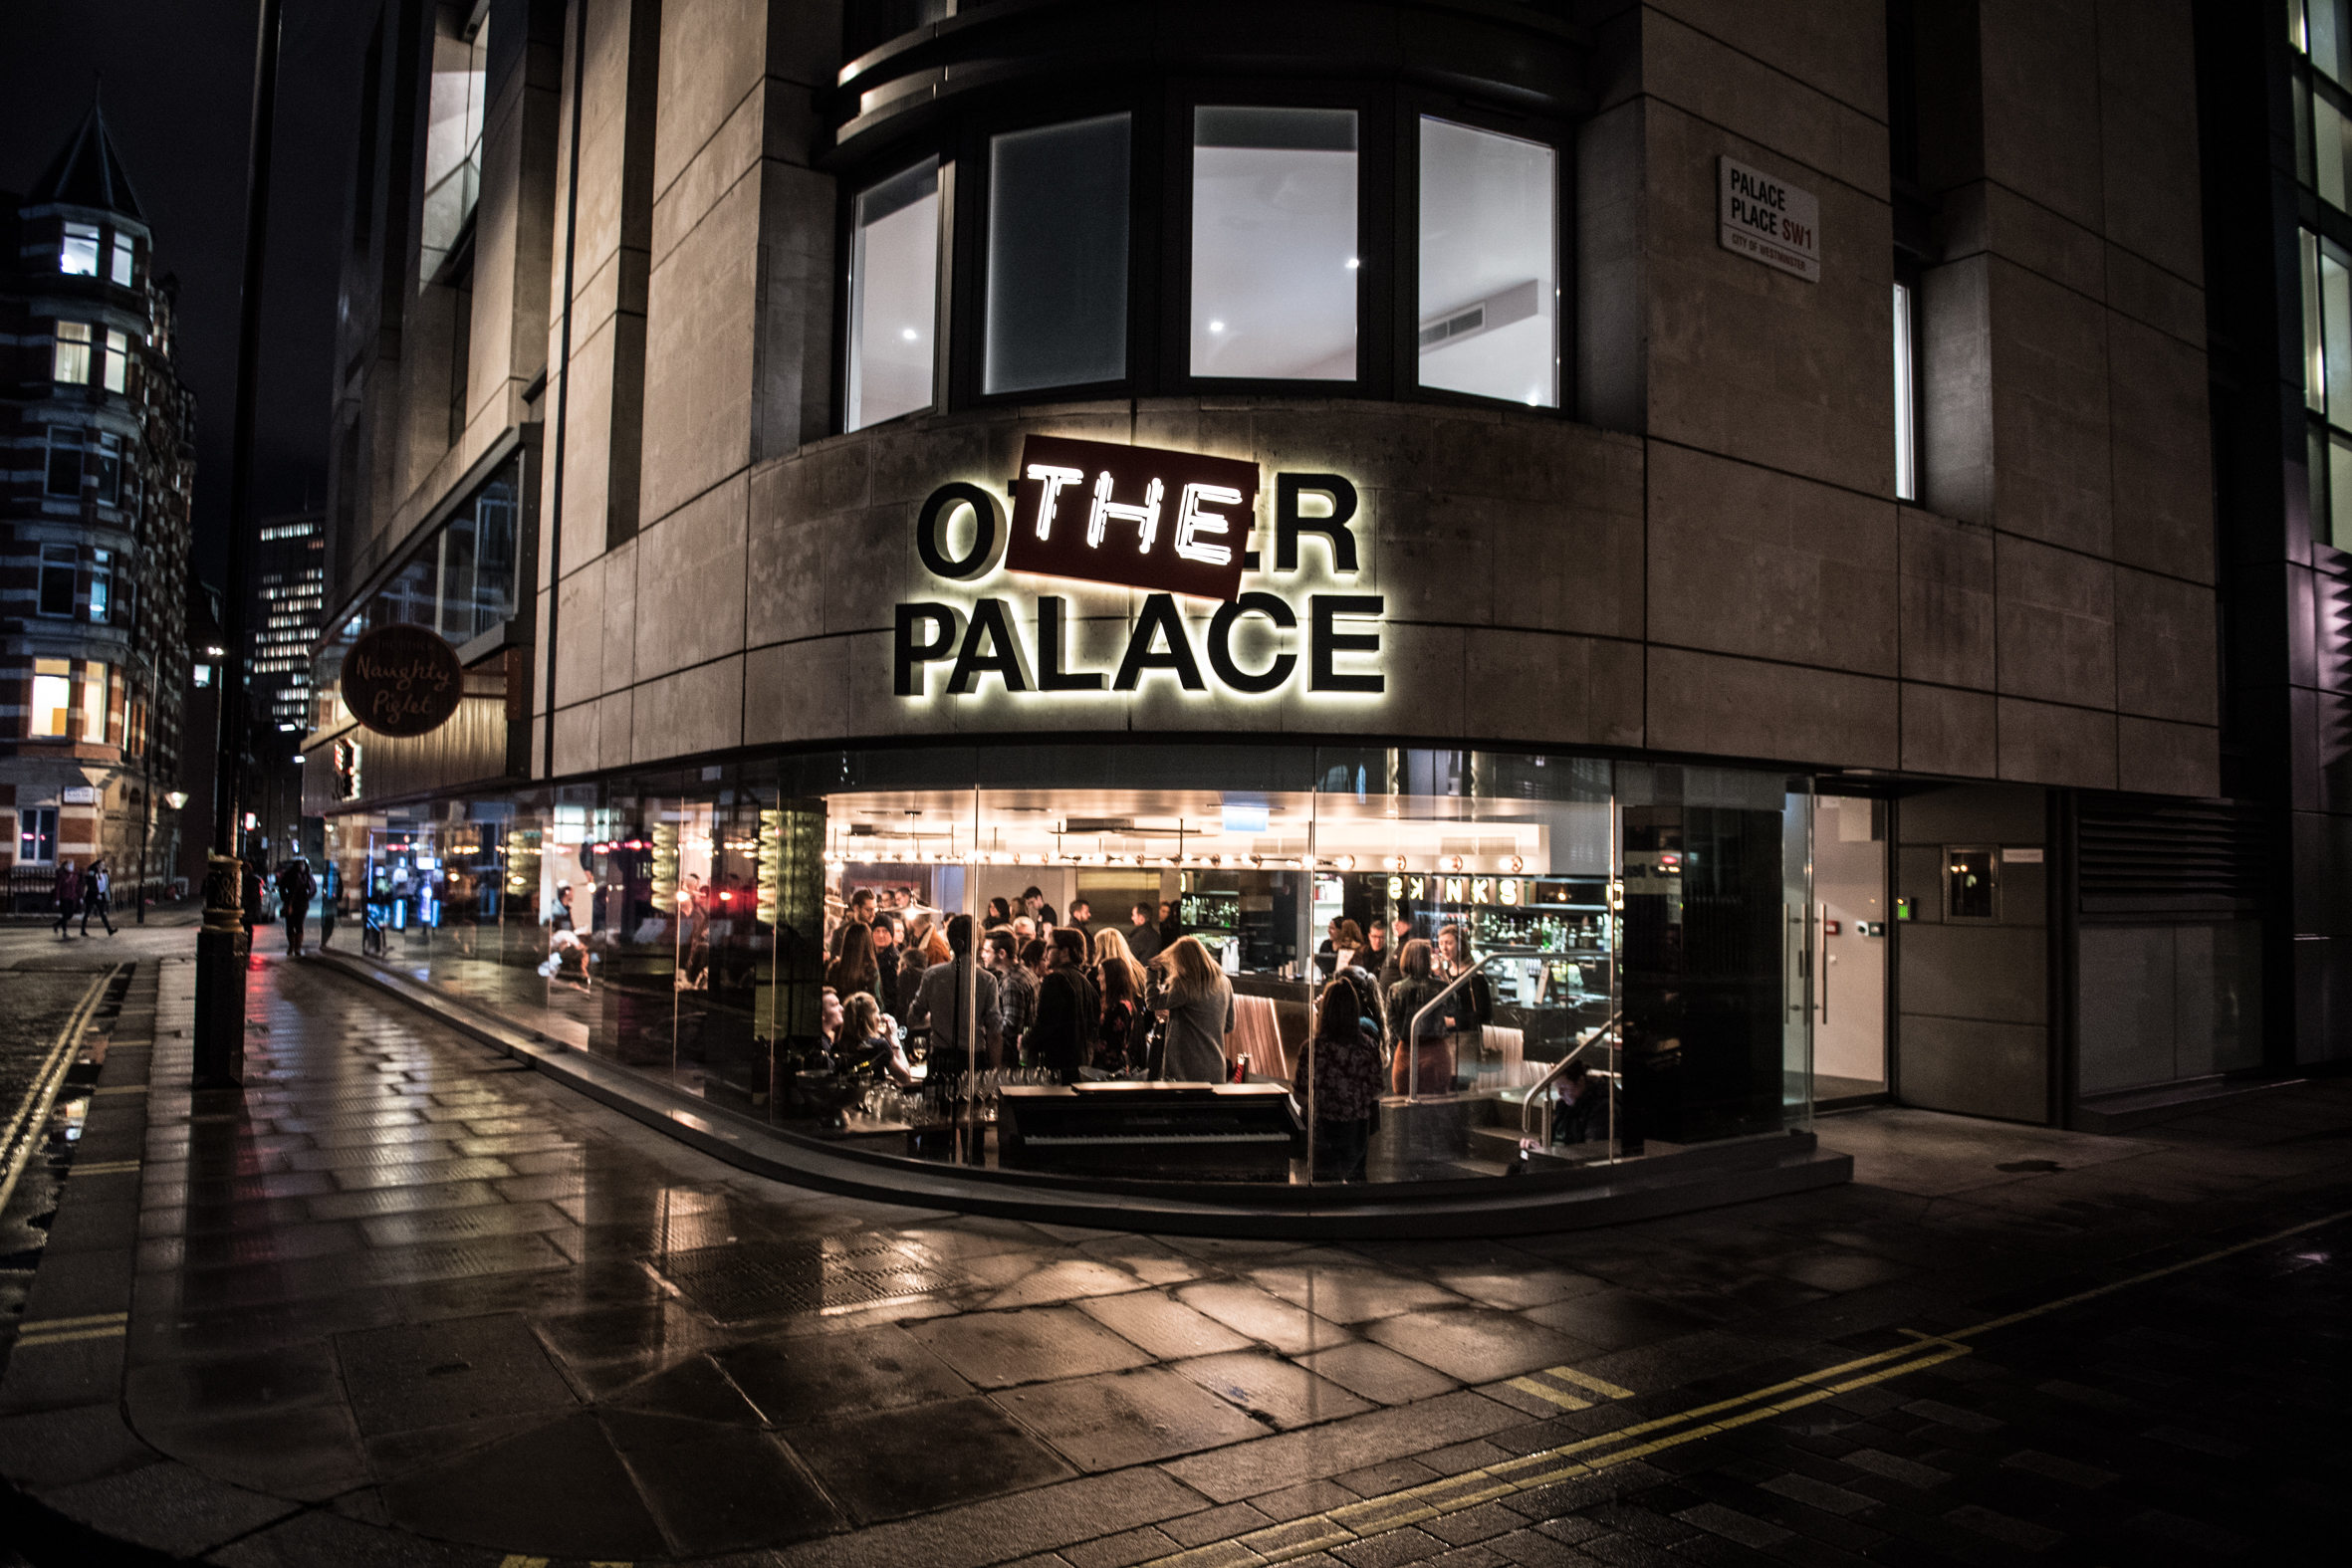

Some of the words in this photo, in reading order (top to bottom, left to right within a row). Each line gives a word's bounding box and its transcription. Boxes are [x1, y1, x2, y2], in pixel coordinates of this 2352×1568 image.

[1731, 168, 1785, 212] PALACE
[1732, 197, 1777, 235] PLACE
[1782, 218, 1811, 250] SW1
[1732, 233, 1748, 248] CITY
[1749, 240, 1758, 251] OF
[1027, 463, 1243, 566] THE
[894, 591, 1385, 697] PALACE
[355, 653, 452, 692] Naughty
[372, 689, 430, 725] Piglet
